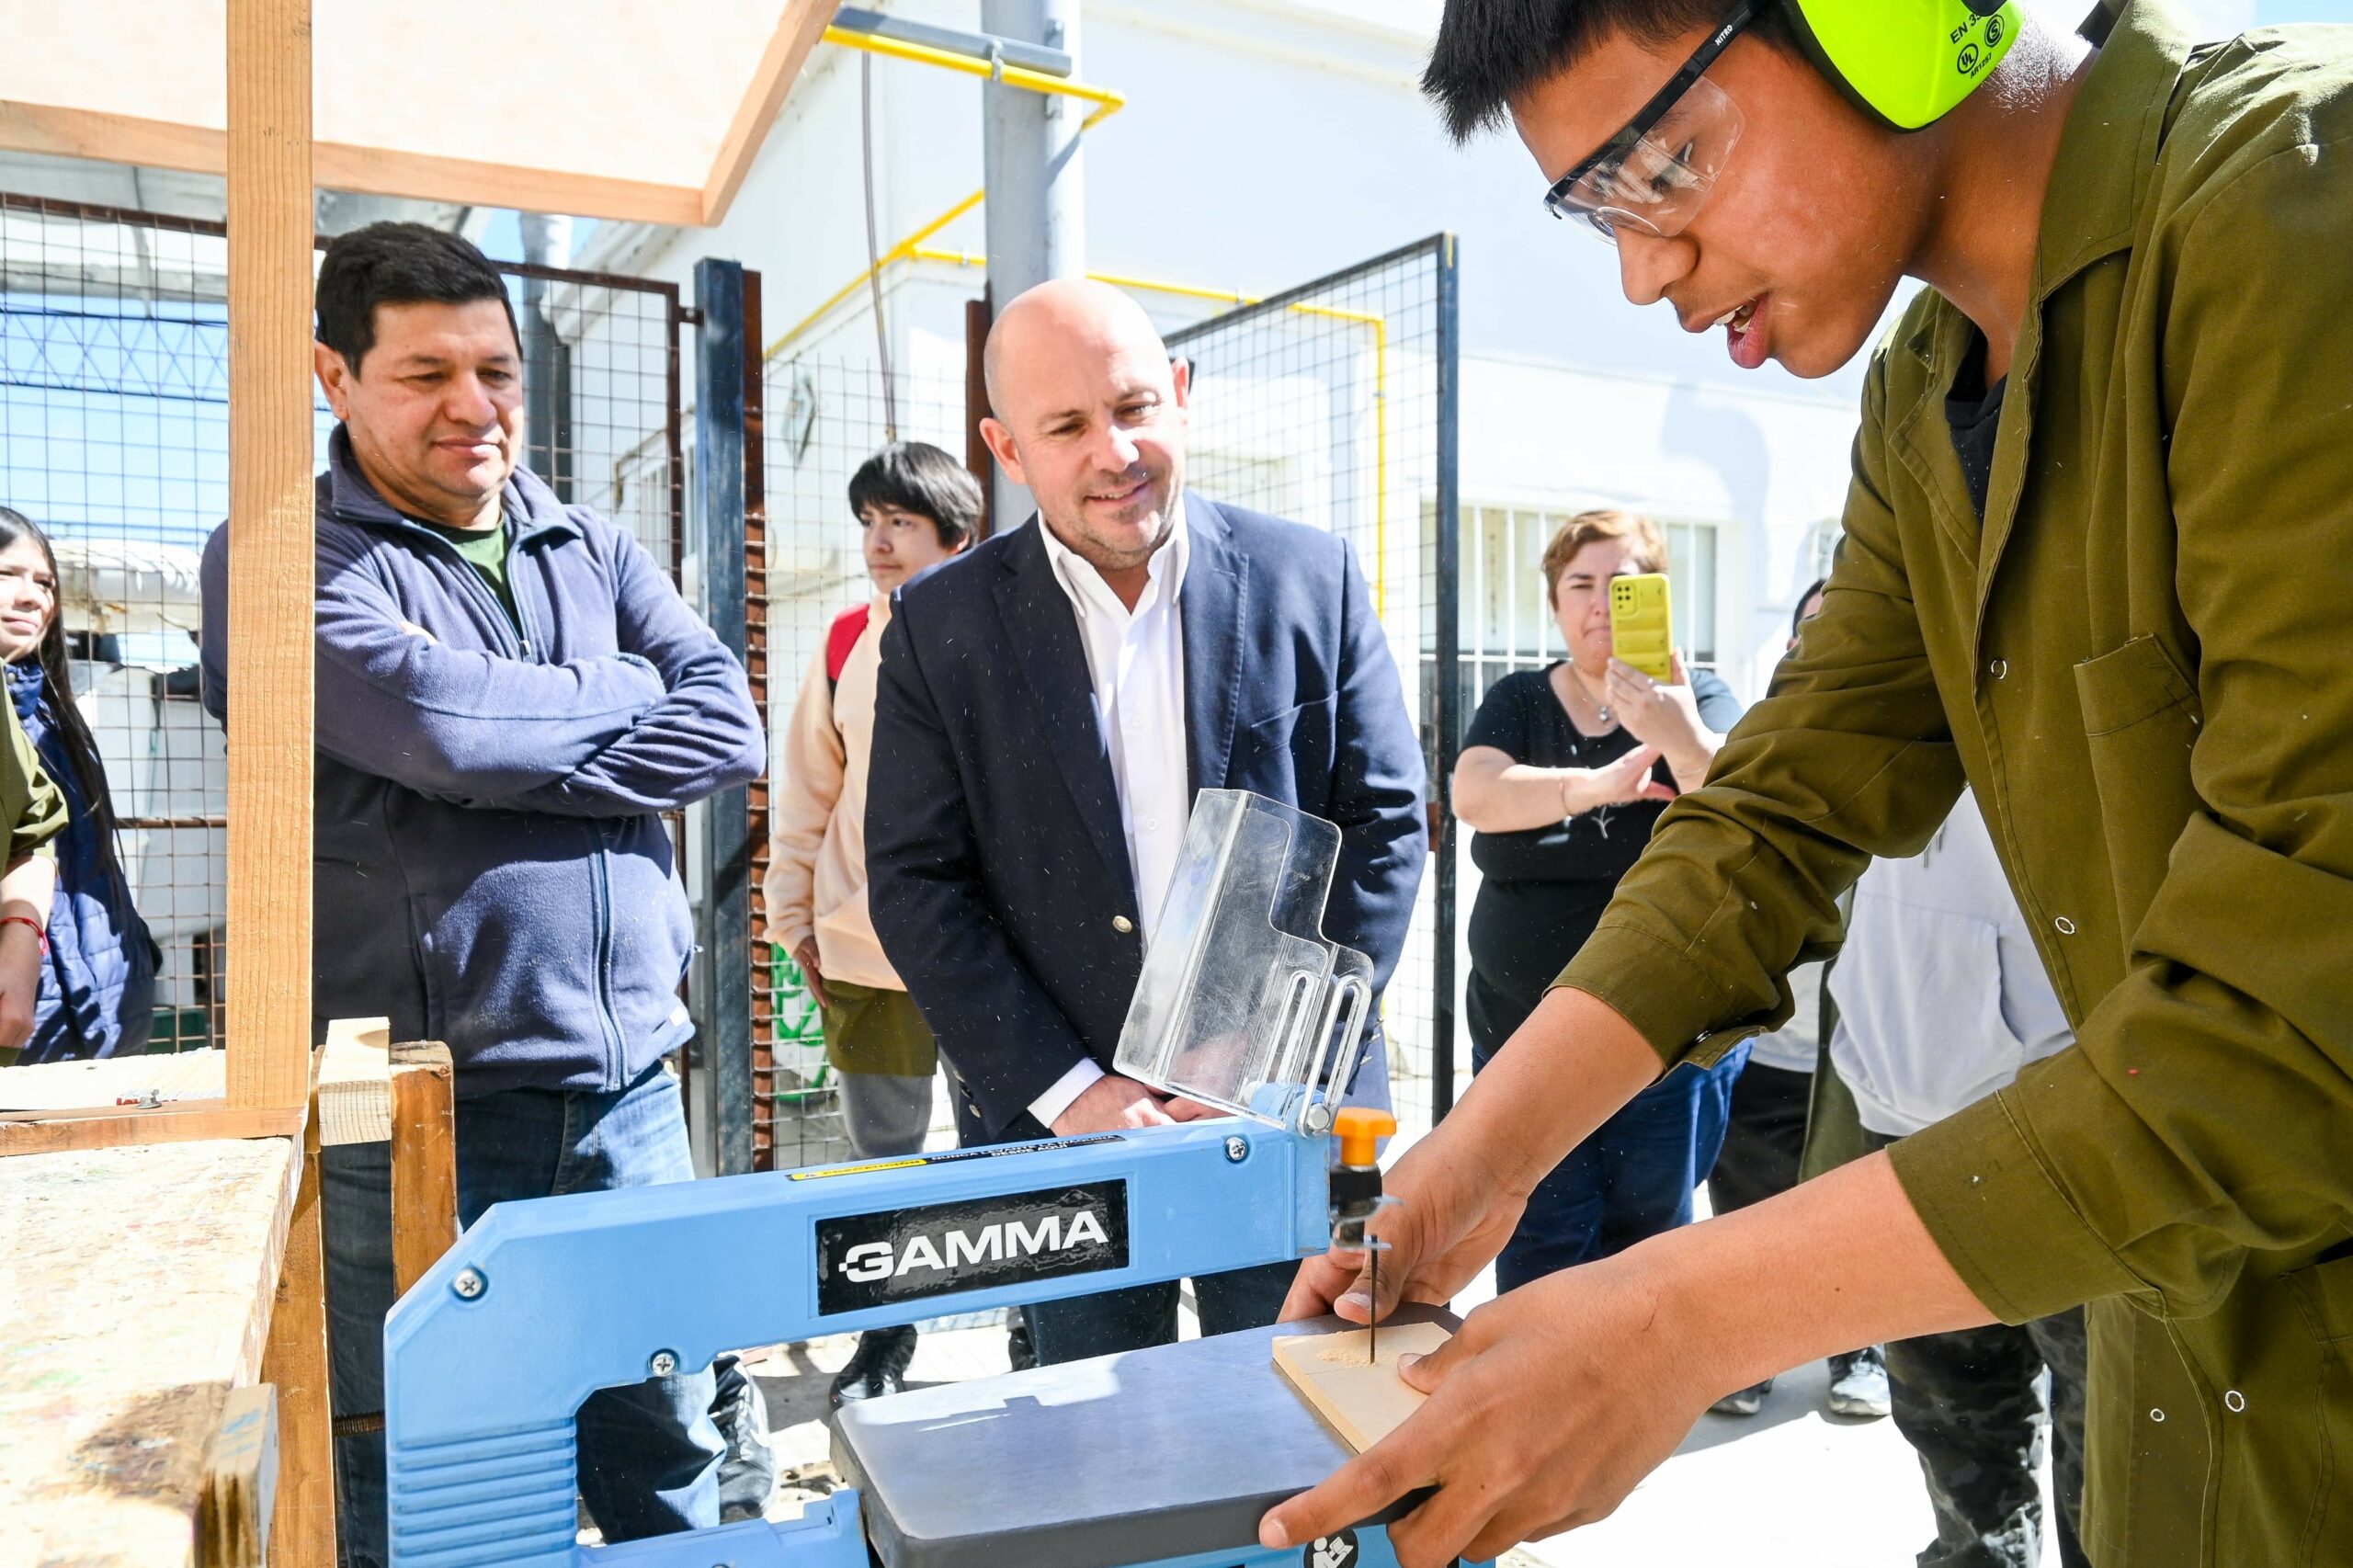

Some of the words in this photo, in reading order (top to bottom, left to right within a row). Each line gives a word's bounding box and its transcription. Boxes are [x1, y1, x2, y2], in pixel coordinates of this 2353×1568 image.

[1714, 24, 1733, 46] NITRO
[1950, 21, 1968, 44] EN
[931, 1151, 979, 1161] NUNCA
[991, 1148, 1035, 1157] DESDE
[838, 1210, 1108, 1283] GAMMA
